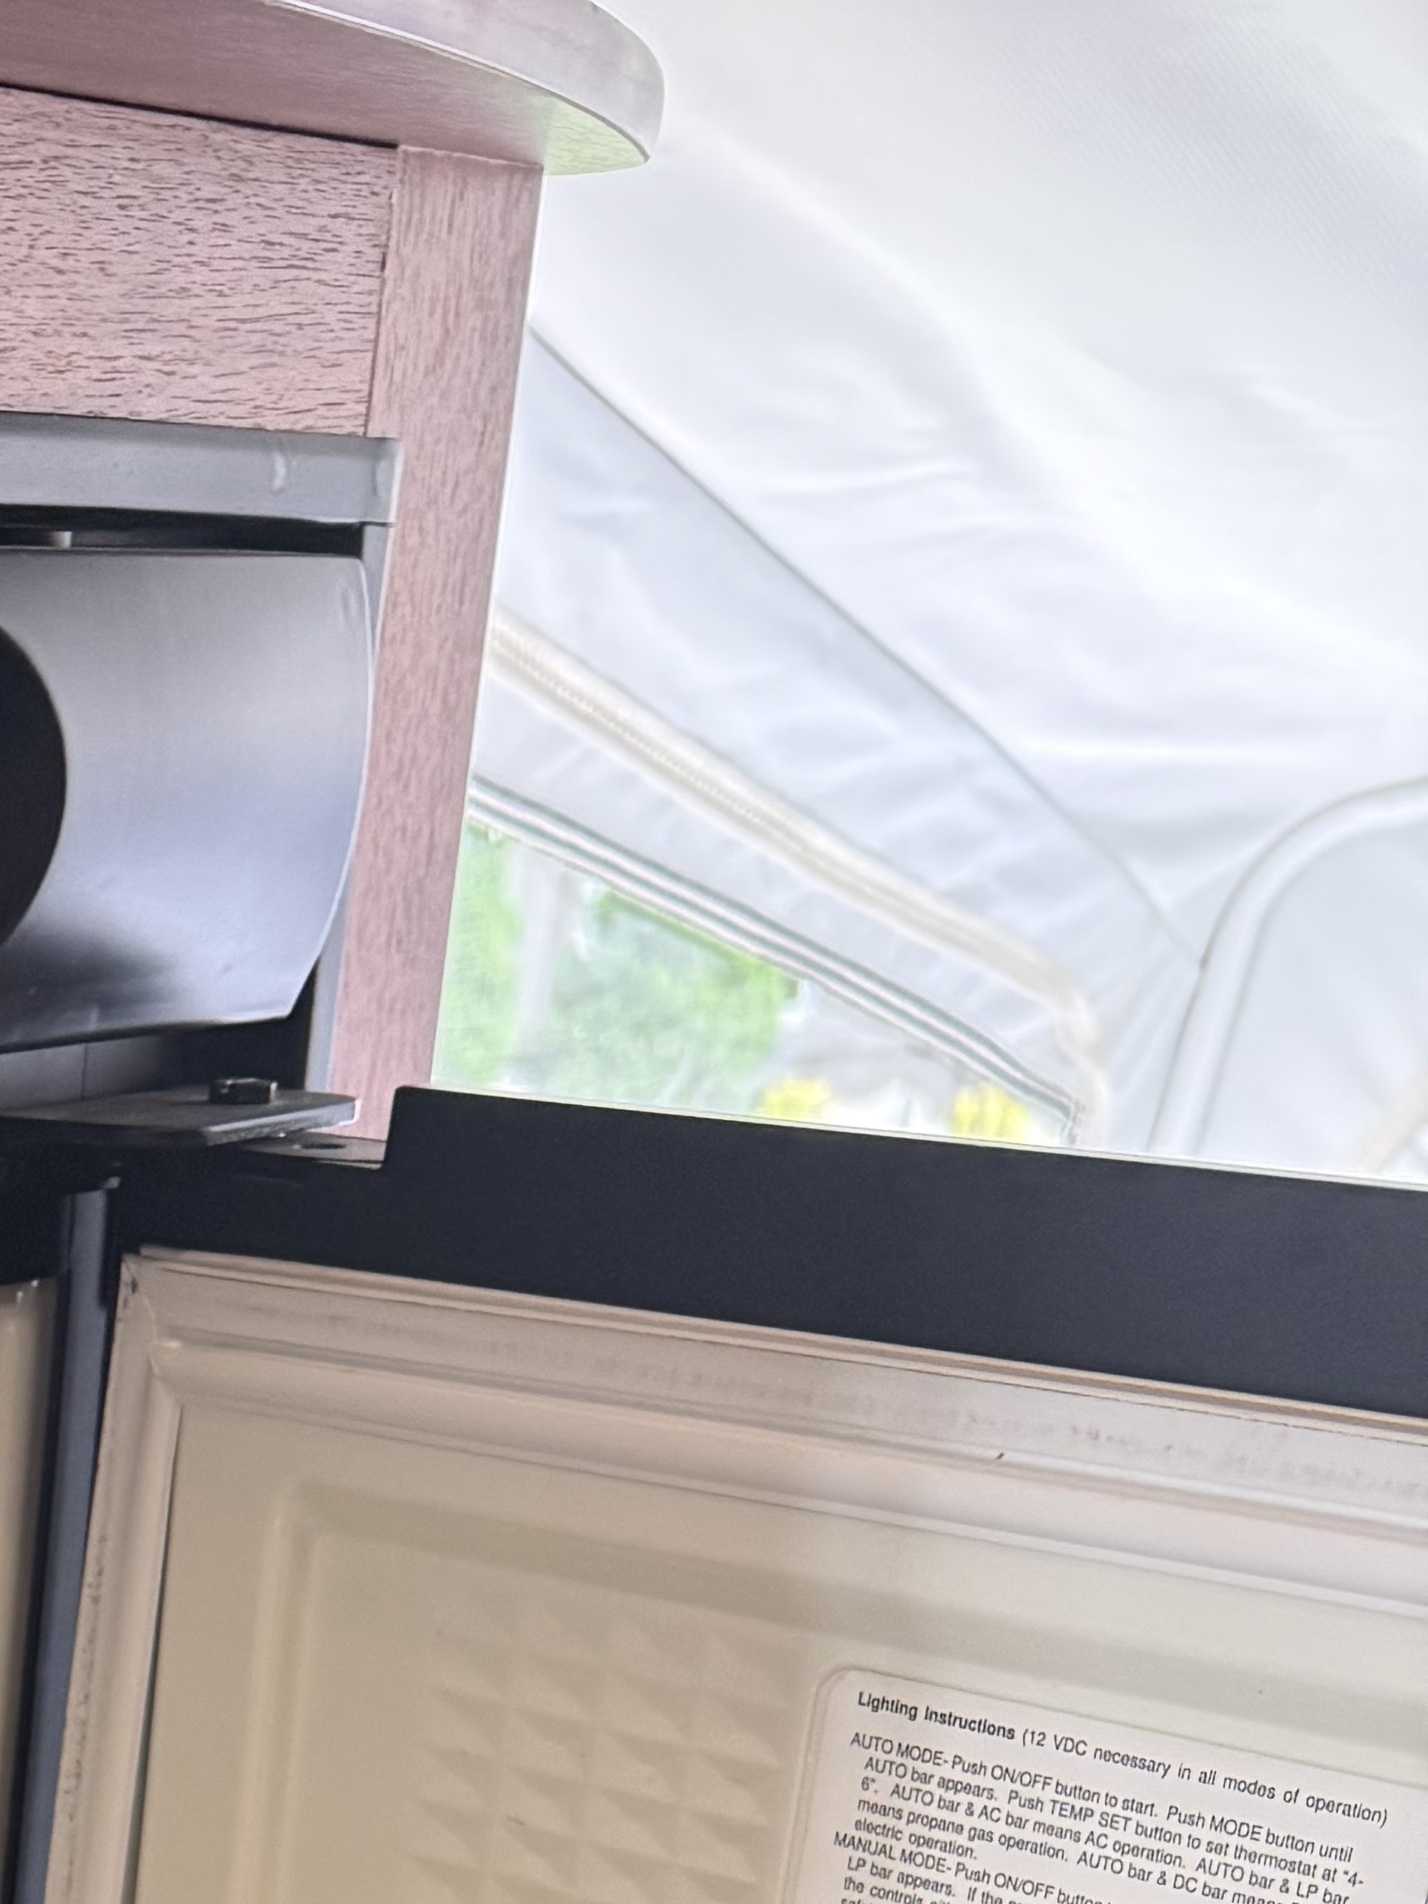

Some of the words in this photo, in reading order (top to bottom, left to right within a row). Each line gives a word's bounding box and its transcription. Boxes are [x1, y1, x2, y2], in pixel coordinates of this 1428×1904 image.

[850, 1732, 894, 1755] AUTO
[951, 1754, 987, 1777] Push
[990, 1764, 1052, 1791] ON/OFF
[1054, 1779, 1101, 1804] button
[1104, 1792, 1118, 1808] to
[1121, 1798, 1158, 1817] start.
[1166, 1805, 1206, 1829] Push
[1209, 1814, 1262, 1842] MODE
[1265, 1828, 1315, 1855] button
[1319, 1844, 1354, 1863] until
[858, 1691, 919, 1722] Lighting
[924, 1705, 1016, 1740] Instructions
[1022, 1728, 1046, 1747] (12
[1053, 1734, 1088, 1756] VDC
[1093, 1747, 1171, 1779] necessary
[1177, 1763, 1192, 1781] in
[1198, 1769, 1217, 1786] all
[1222, 1777, 1276, 1799] modes
[1283, 1788, 1300, 1804] of
[1306, 1795, 1388, 1828] operation)
[833, 1831, 896, 1861] MANUAL
[954, 1862, 991, 1885] Push
[994, 1872, 1055, 1899] ON/OFF
[854, 1817, 903, 1842] electric
[908, 1833, 977, 1860] operation.
[857, 1799, 904, 1821] means
[906, 1811, 964, 1835] propane
[967, 1826, 994, 1843] gas
[998, 1833, 1068, 1862] operation.
[1076, 1850, 1124, 1875] AUTO
[1127, 1862, 1153, 1882] bar
[1156, 1870, 1167, 1886] &
[1173, 1873, 1198, 1893] DC
[1201, 1880, 1228, 1900] bar
[864, 1756, 908, 1779] AUTO
[910, 1766, 935, 1785] bar
[937, 1776, 997, 1801] appears.
[1007, 1789, 1044, 1813] Push
[1050, 1799, 1095, 1822] TEMP
[1098, 1811, 1132, 1832] SET
[1134, 1820, 1182, 1846] button
[1187, 1834, 1201, 1850] to
[1205, 1840, 1230, 1857] set
[1234, 1844, 1318, 1878] thermostat
[1321, 1867, 1338, 1883] at
[890, 1783, 934, 1807] AUTO
[937, 1794, 961, 1813] bar
[964, 1801, 975, 1817] &
[977, 1804, 1002, 1823] AC
[1005, 1810, 1030, 1830] bar
[1032, 1821, 1081, 1843] means
[1084, 1830, 1109, 1849] AC
[1112, 1840, 1186, 1869] operation.
[1195, 1857, 1245, 1882] AUTO
[1248, 1870, 1276, 1890] bar
[1279, 1878, 1290, 1894] &
[1296, 1881, 1319, 1899] LP
[844, 1876, 865, 1894] the
[847, 1856, 867, 1872] LP
[870, 1861, 893, 1880] bar
[896, 1871, 956, 1897] appears.
[967, 1886, 977, 1902] If
